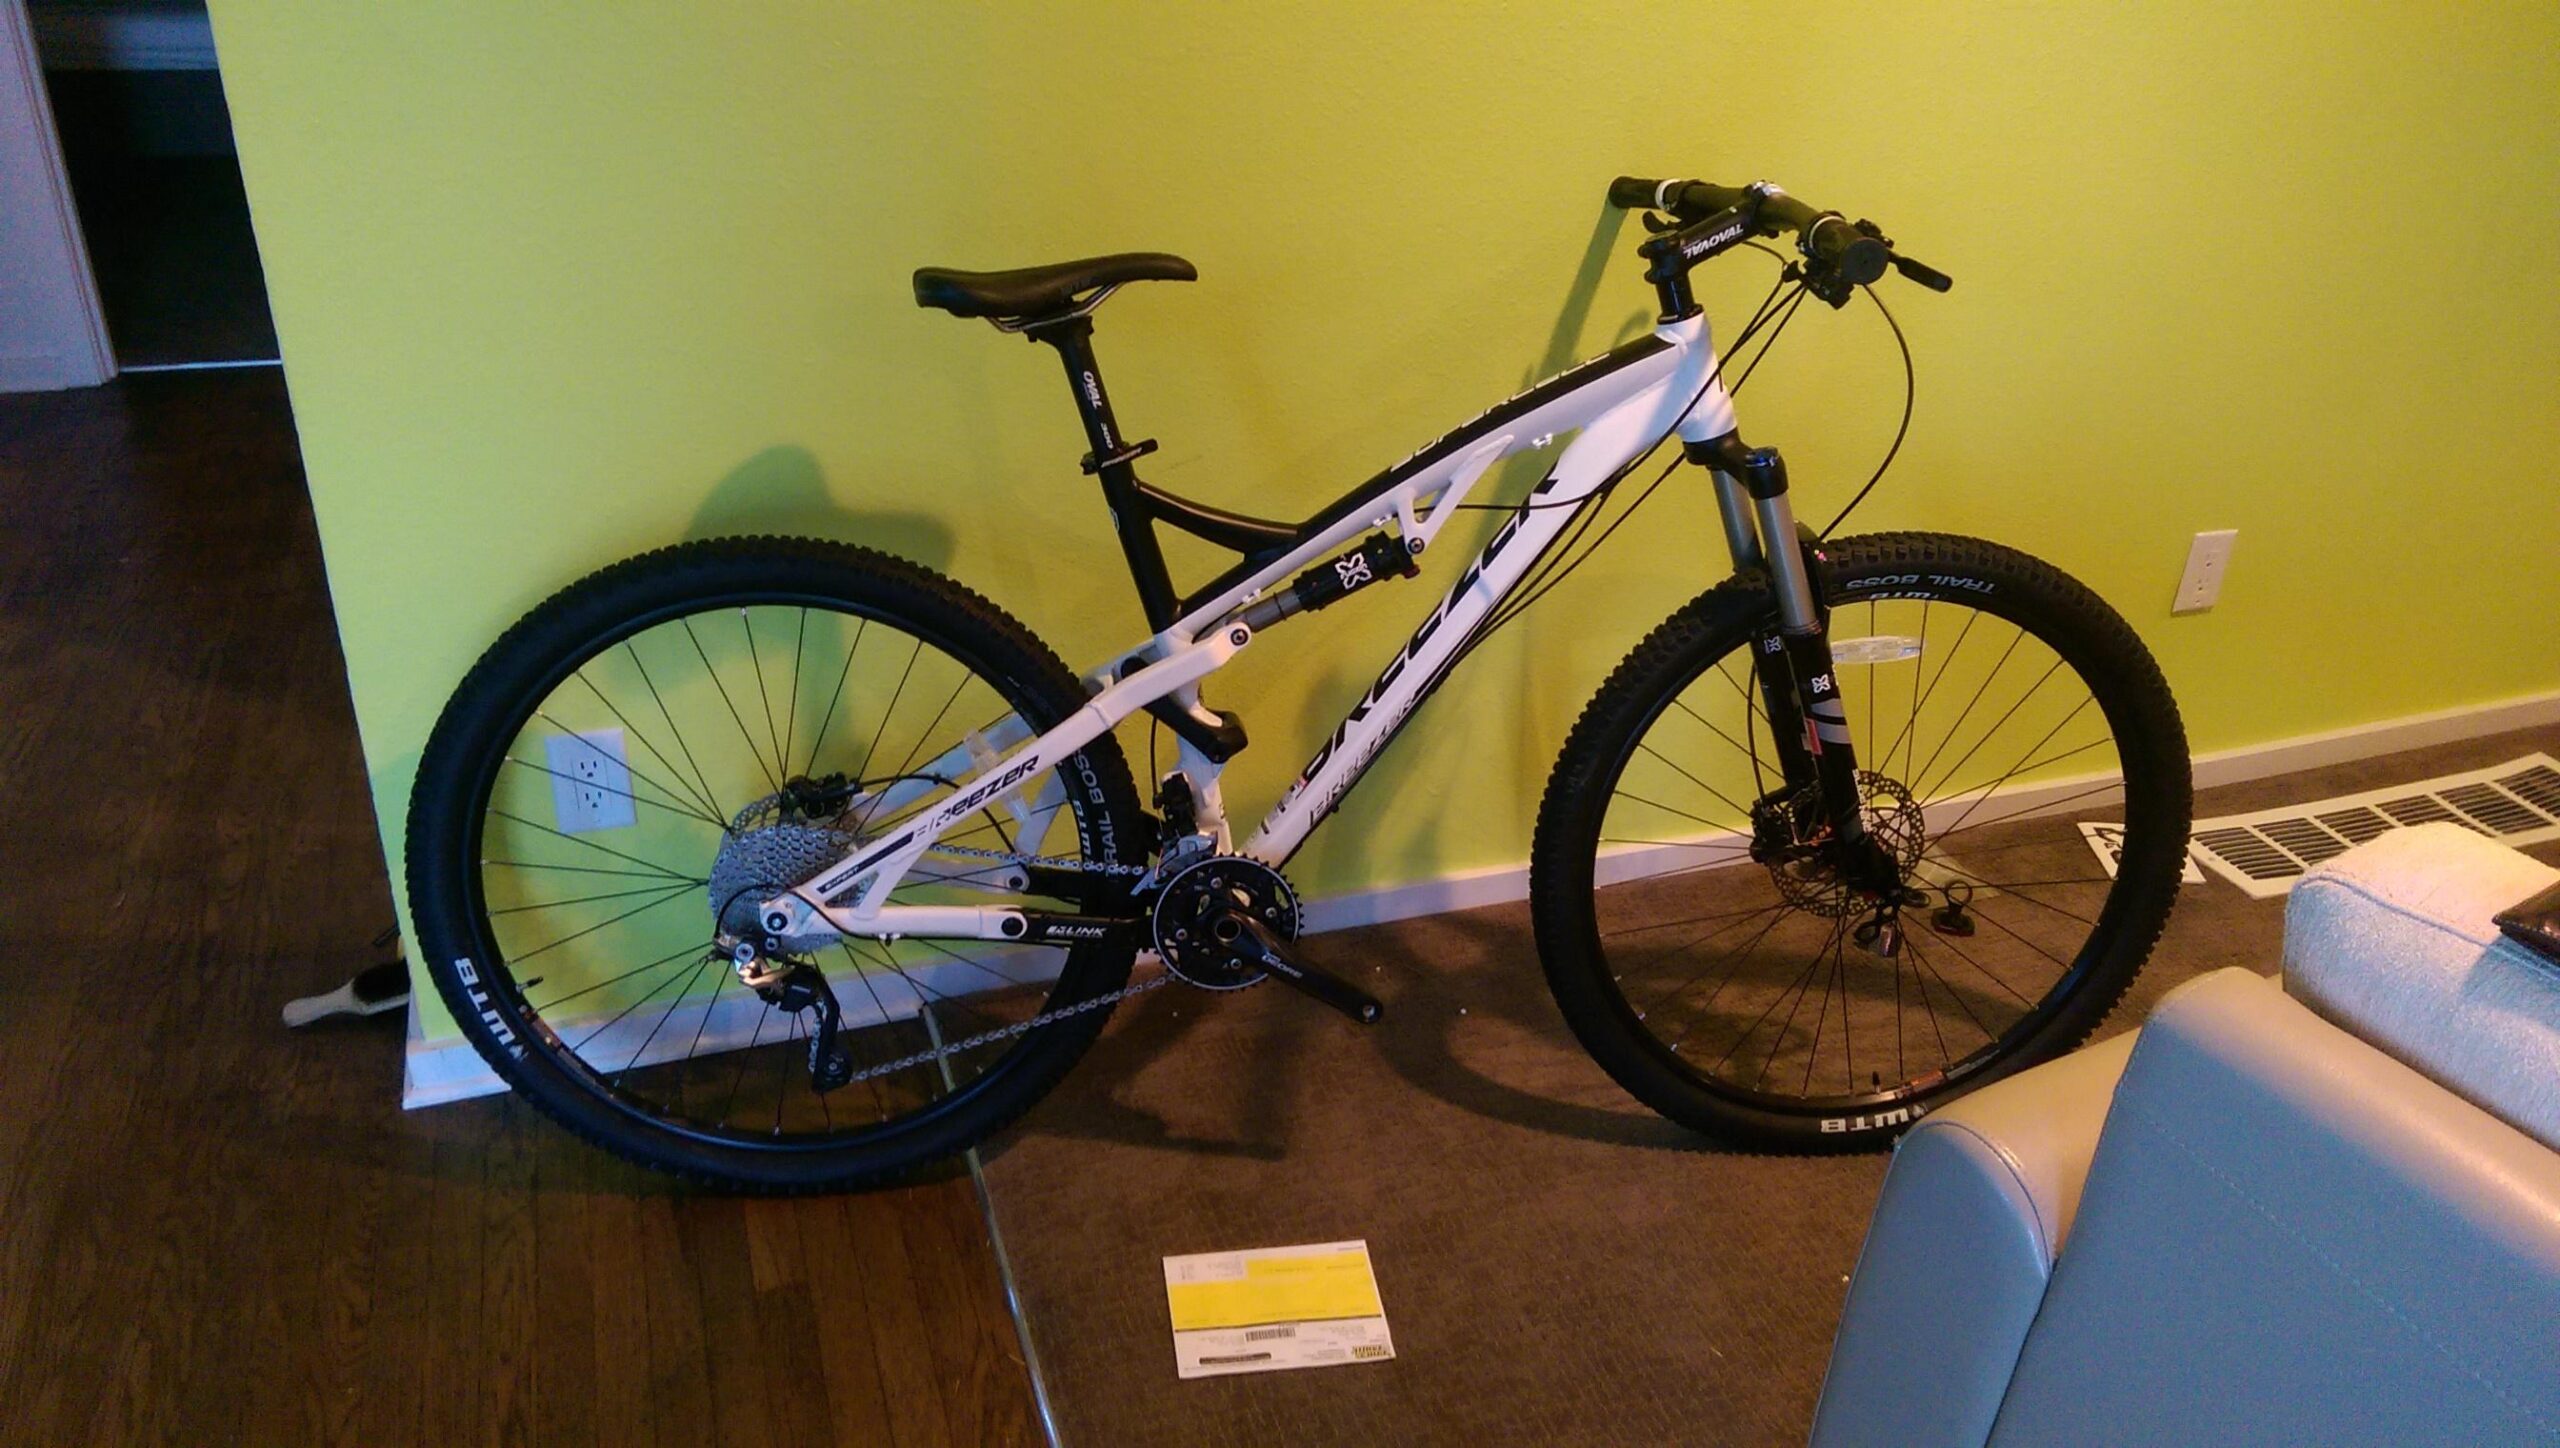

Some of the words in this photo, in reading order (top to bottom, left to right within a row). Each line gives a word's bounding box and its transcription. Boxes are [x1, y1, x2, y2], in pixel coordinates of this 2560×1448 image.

[1083, 371, 1102, 409] OVAL
[1846, 574, 1920, 590] BOSS
[1928, 574, 1995, 594] TRAIL
[1071, 749, 1105, 804] BOS
[1097, 810, 1119, 877] RAIL
[454, 957, 516, 1046] WTB
[1820, 1107, 1910, 1134] WTB
